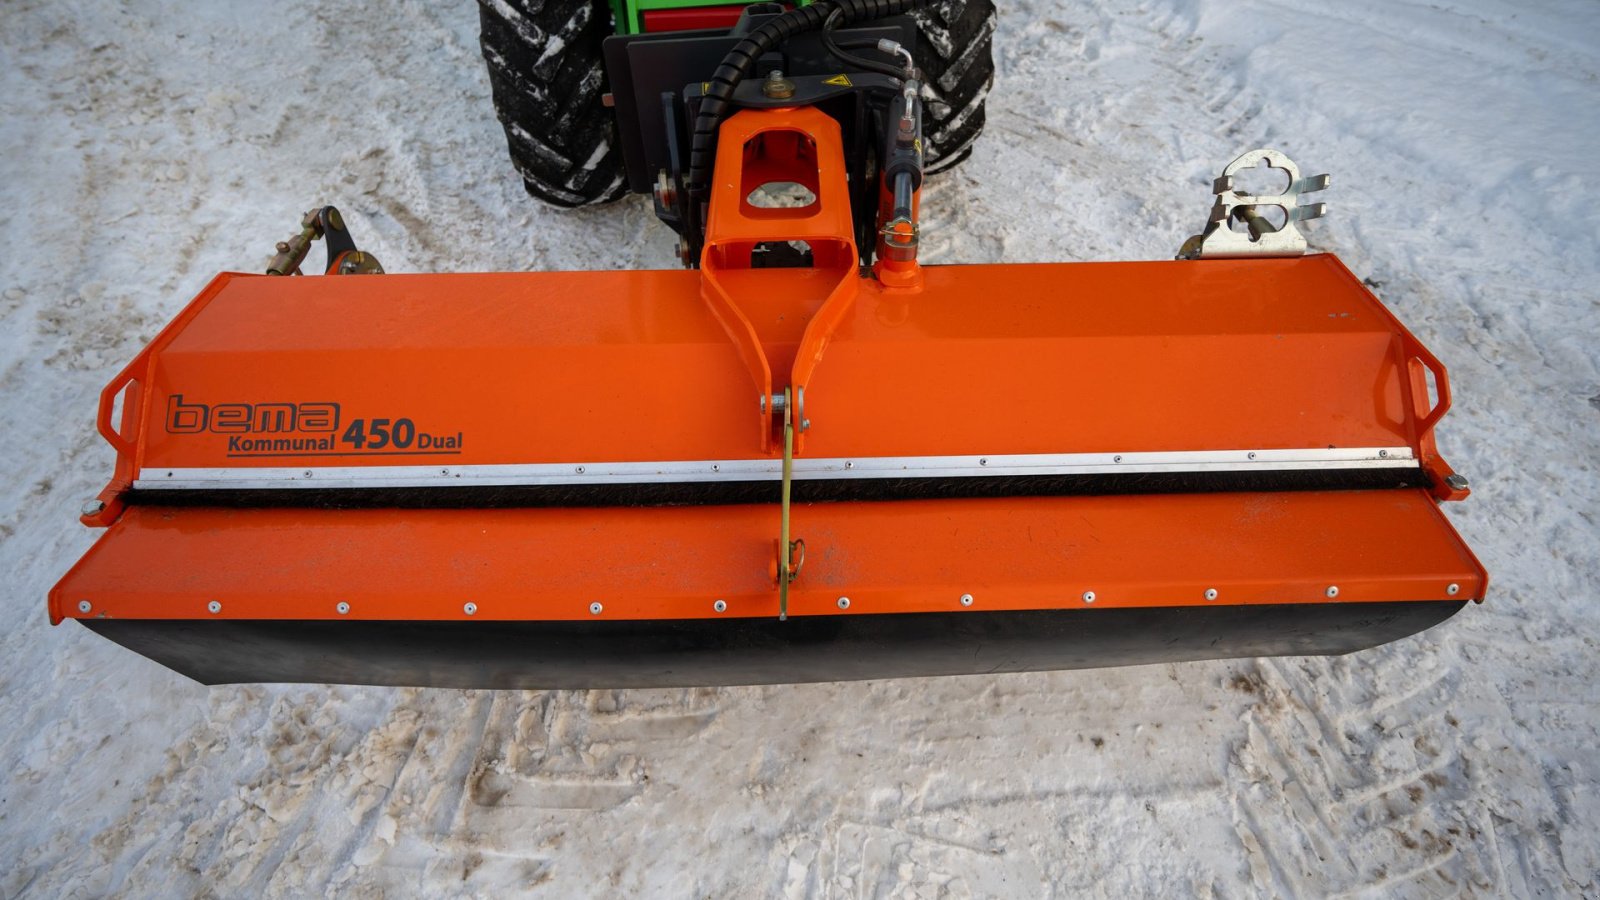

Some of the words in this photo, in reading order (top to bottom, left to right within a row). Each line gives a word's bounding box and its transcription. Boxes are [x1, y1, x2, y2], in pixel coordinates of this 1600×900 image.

[165, 394, 341, 434] bema
[228, 434, 335, 451] Kommunal
[342, 418, 415, 449] 450
[418, 432, 463, 449] Dual
